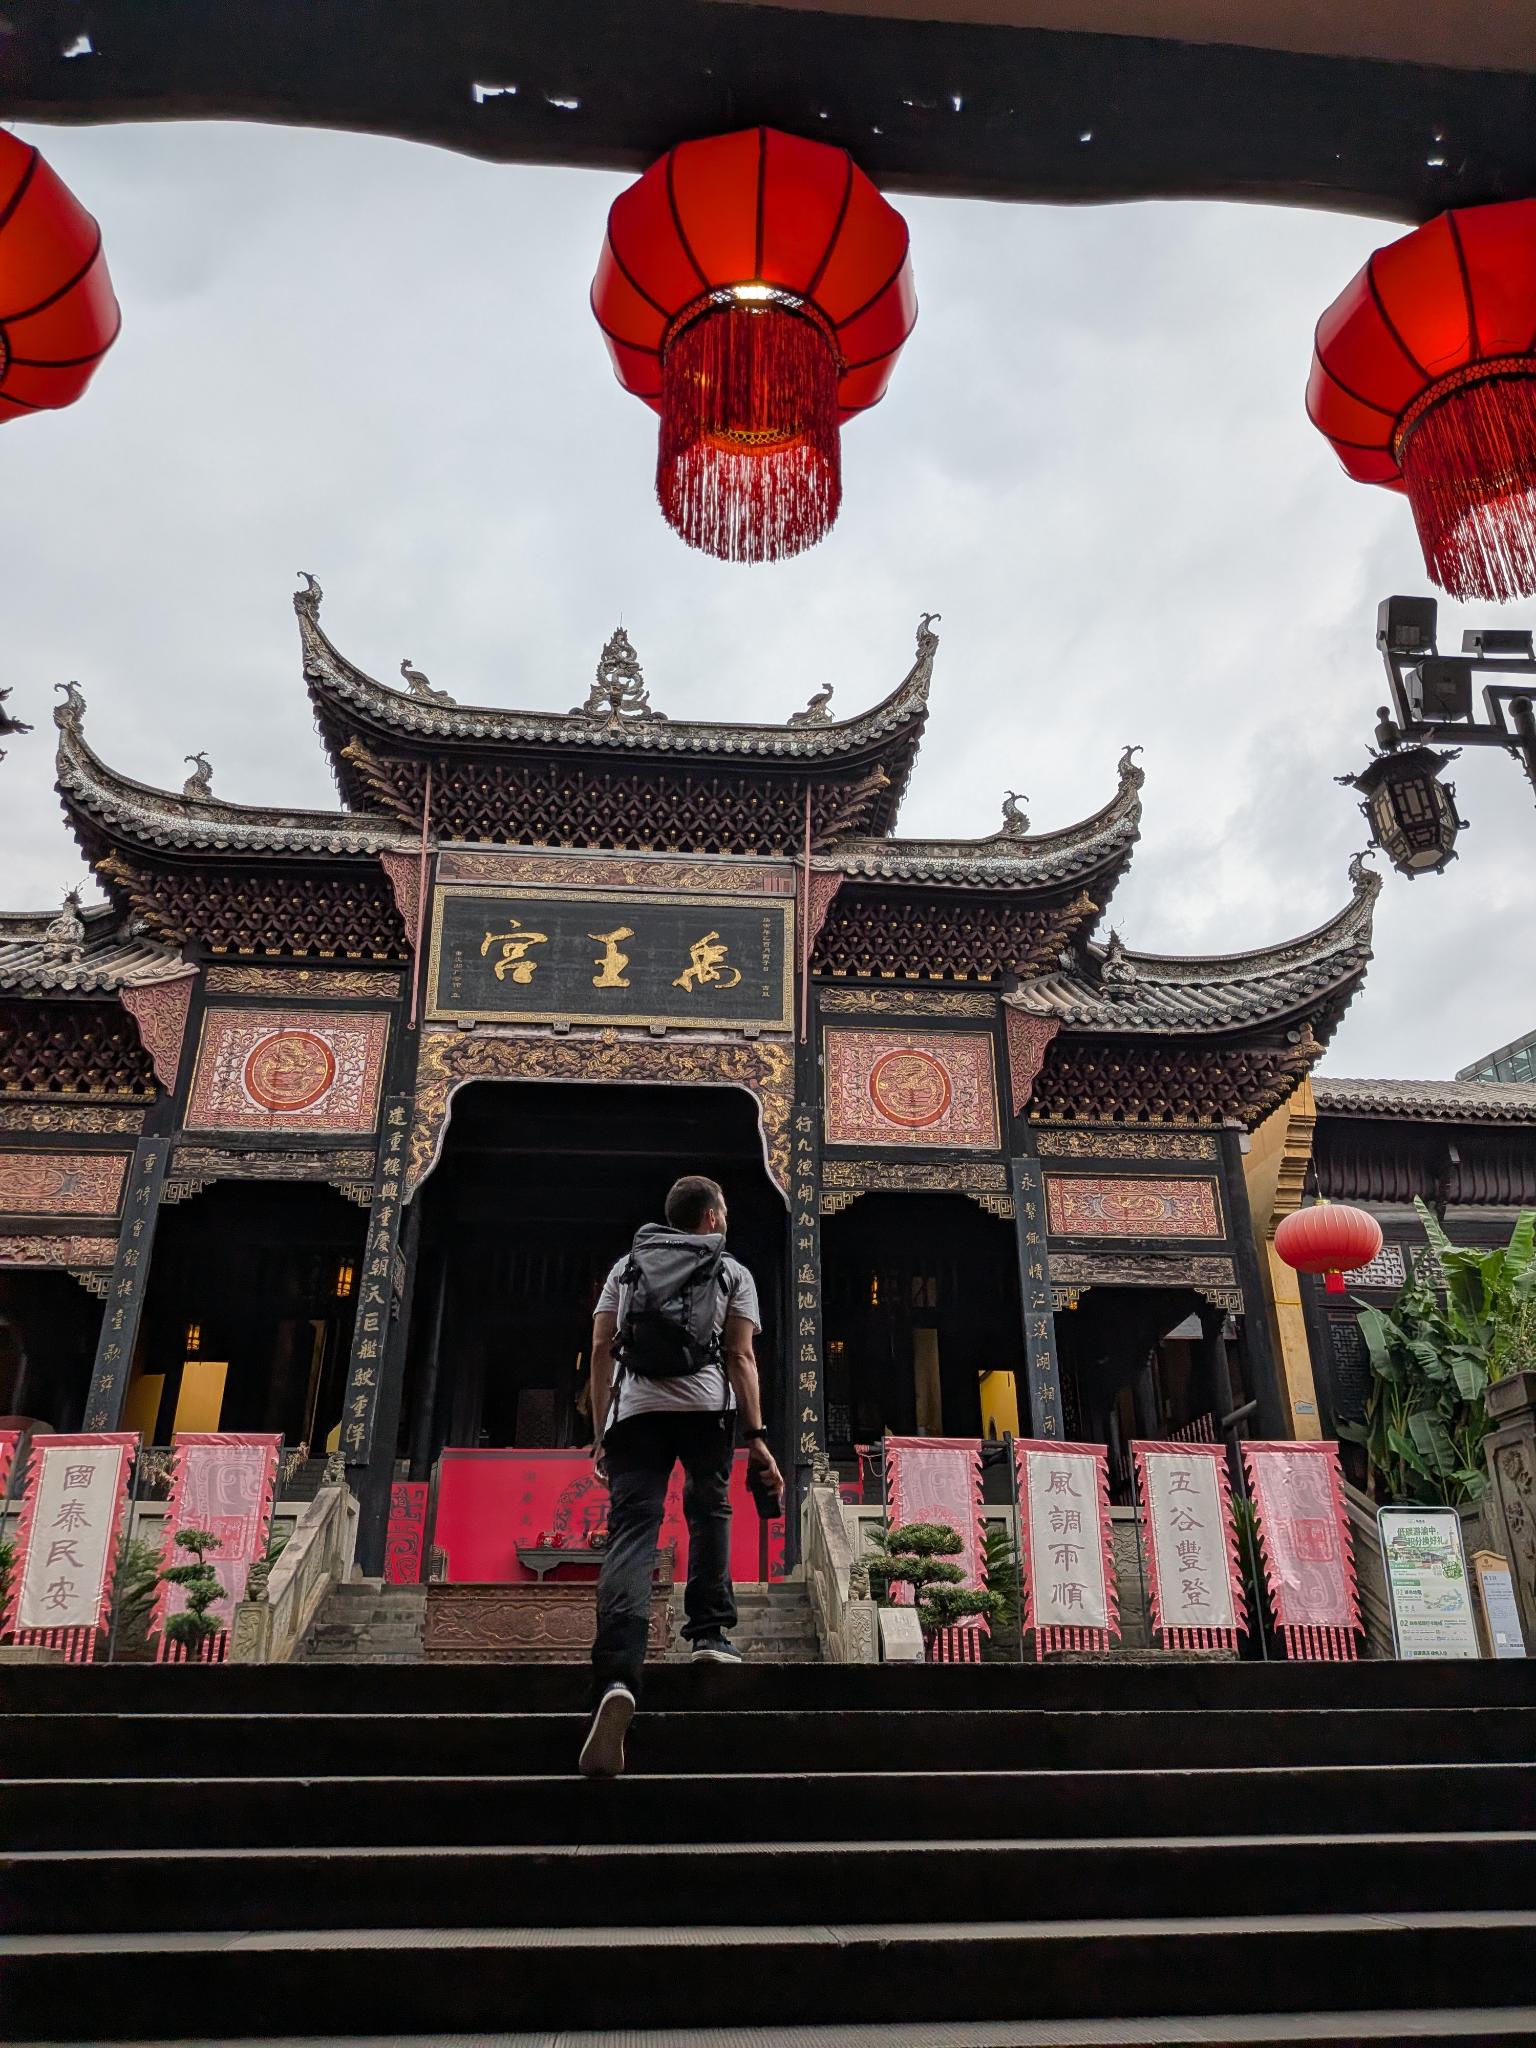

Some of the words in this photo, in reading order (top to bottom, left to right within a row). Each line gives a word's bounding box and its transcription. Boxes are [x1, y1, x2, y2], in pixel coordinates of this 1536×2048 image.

[40, 1464, 96, 1611] 國泰民安
[1044, 1470, 1089, 1610] 風調雨順
